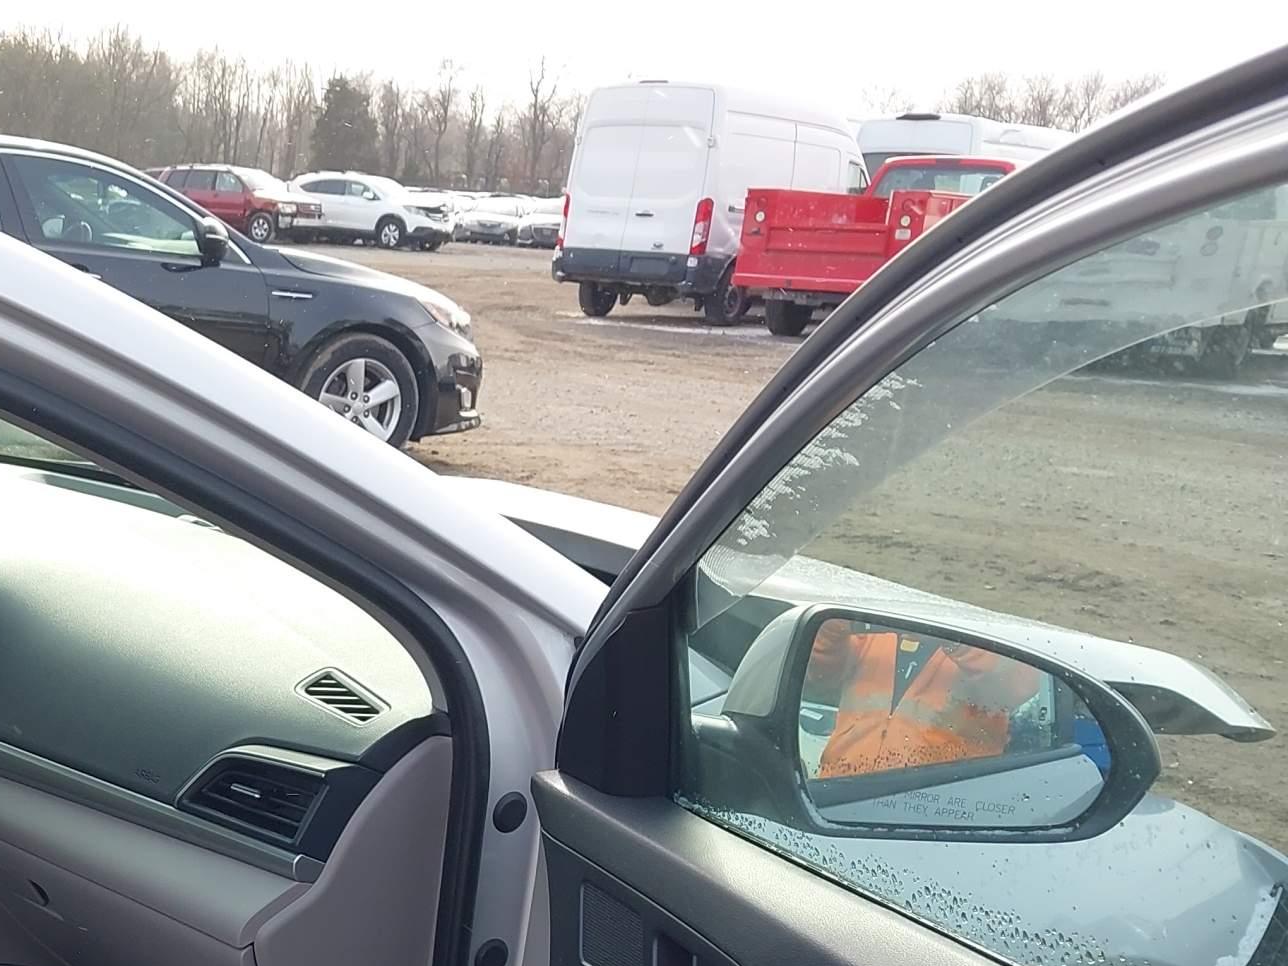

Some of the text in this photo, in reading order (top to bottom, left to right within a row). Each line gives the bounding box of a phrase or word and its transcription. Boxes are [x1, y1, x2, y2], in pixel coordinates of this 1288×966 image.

[903, 802, 929, 815] THEY
[934, 808, 975, 822] APPEAR
[904, 791, 940, 805] MIRROR
[947, 796, 966, 809] ARE
[975, 800, 1016, 816] CLOSER
